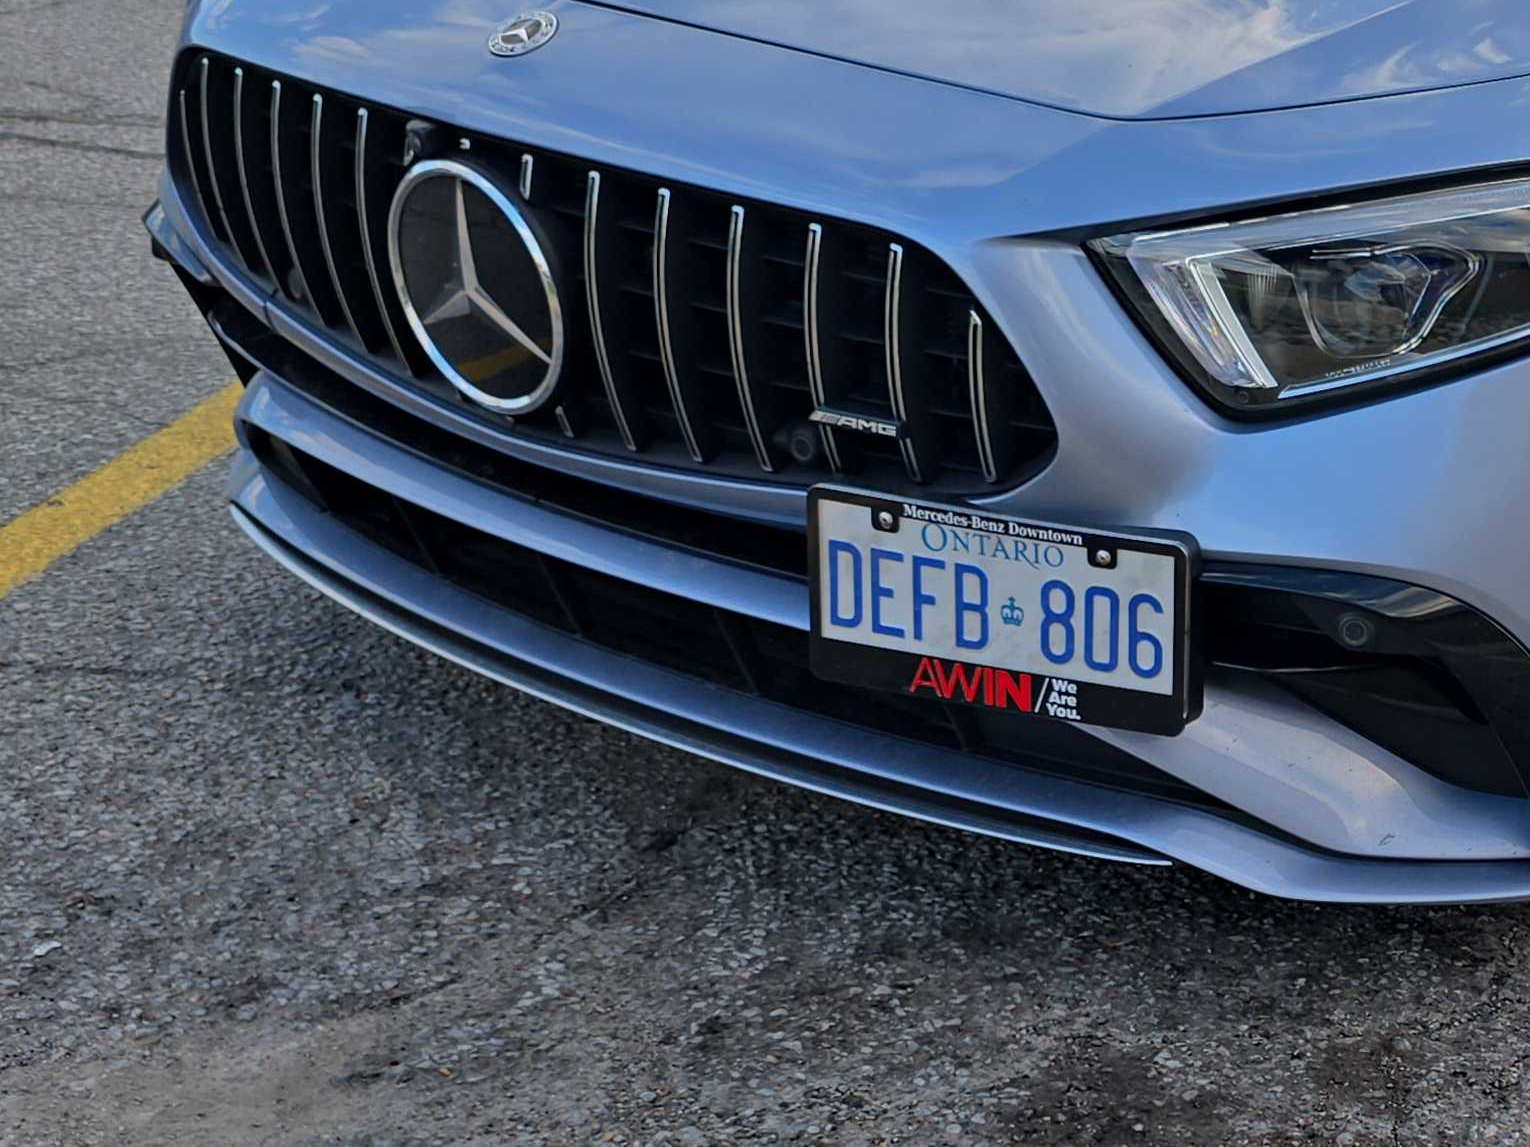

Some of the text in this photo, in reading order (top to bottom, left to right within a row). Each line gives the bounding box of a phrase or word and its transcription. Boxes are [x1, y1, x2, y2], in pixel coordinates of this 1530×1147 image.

[837, 415, 897, 437] AMG
[903, 504, 1083, 545] Mercedes-Benz Downtown
[922, 523, 1064, 570] ONTARIO
[827, 539, 1165, 679] DEFB 806
[909, 657, 1032, 713] AWIN
[1049, 691, 1077, 707] Are
[1051, 678, 1077, 694] We
[1045, 702, 1081, 720] You.
